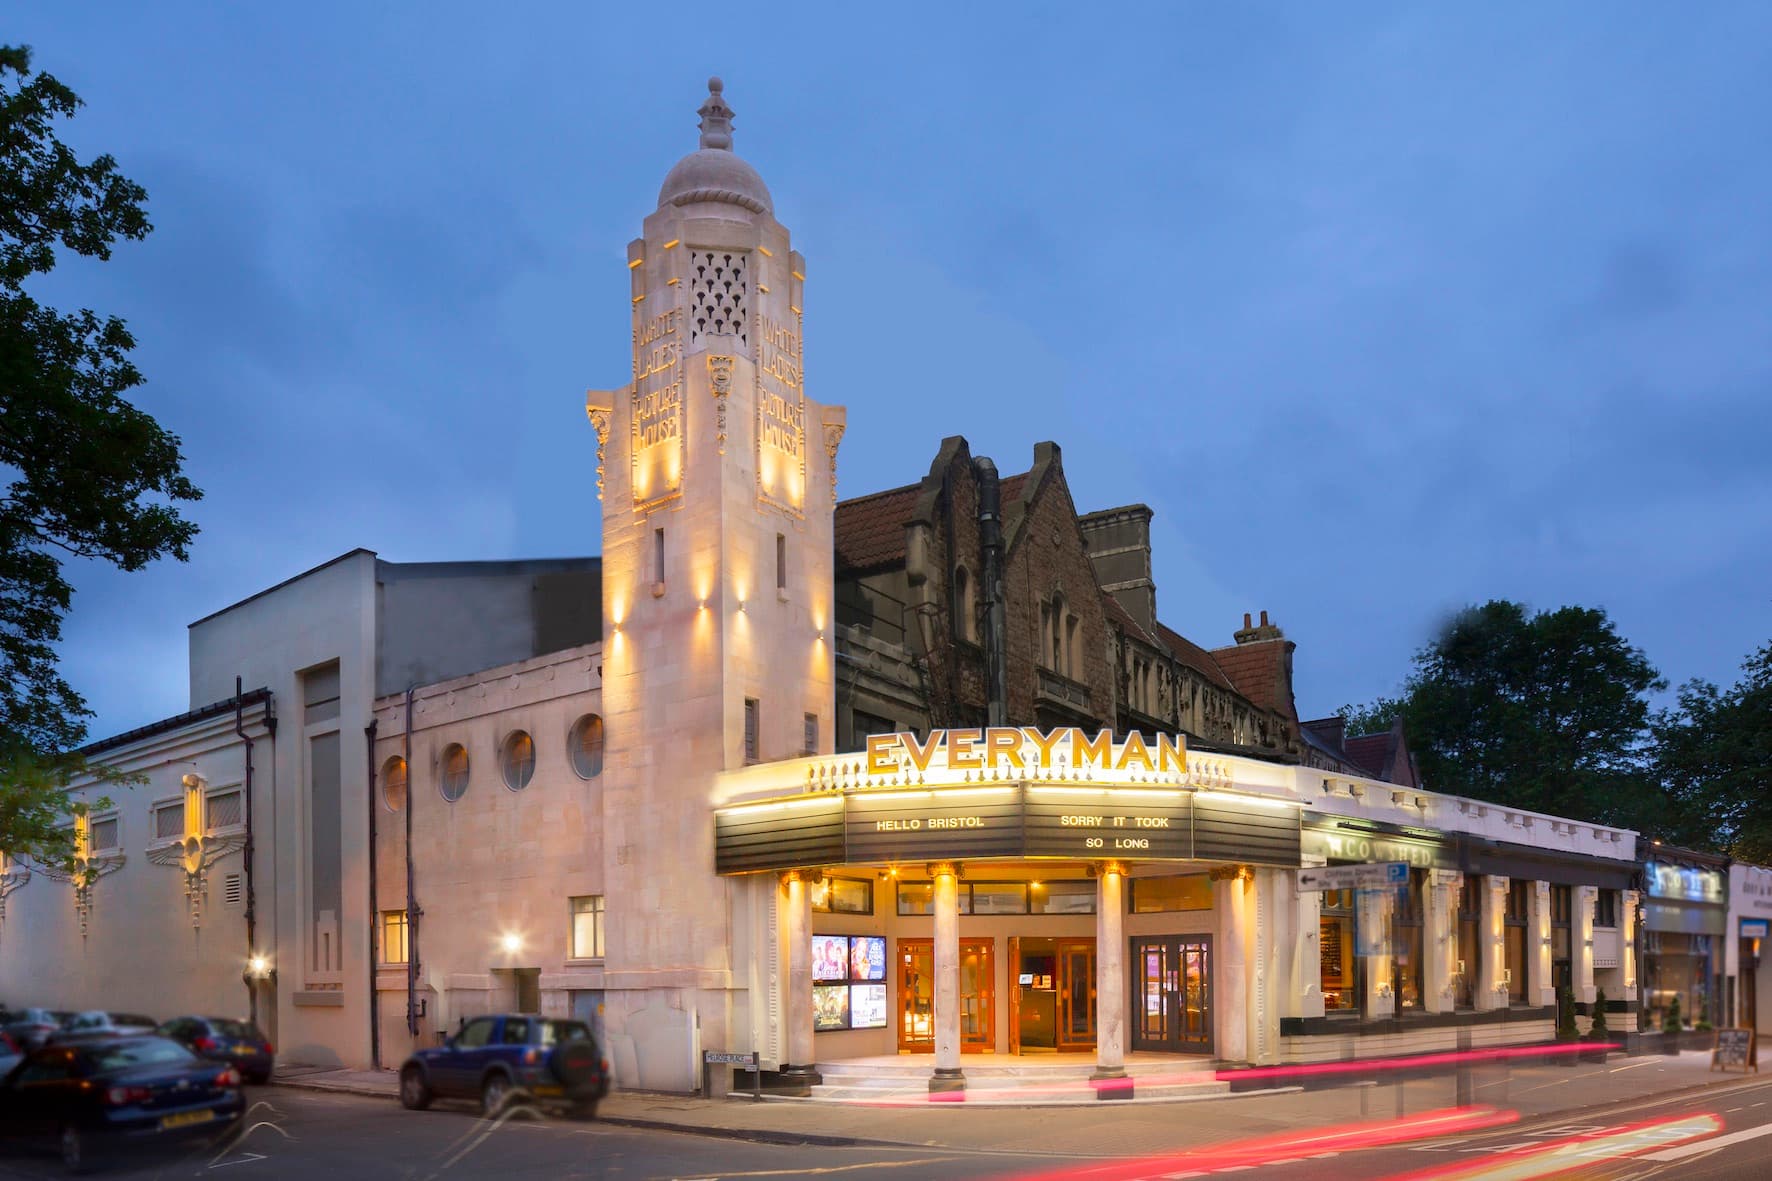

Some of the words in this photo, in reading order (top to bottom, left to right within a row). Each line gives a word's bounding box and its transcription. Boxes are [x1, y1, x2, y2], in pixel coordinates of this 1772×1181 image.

[866, 726, 1187, 775] EVERYMAN
[876, 819, 920, 831] HELLO
[928, 816, 984, 828] BRISTOL
[1060, 815, 1103, 827] SORRY
[1113, 816, 1124, 826] IT
[1135, 817, 1169, 828] TOOK
[1086, 837, 1103, 848] SO
[1115, 837, 1149, 849] LONG
